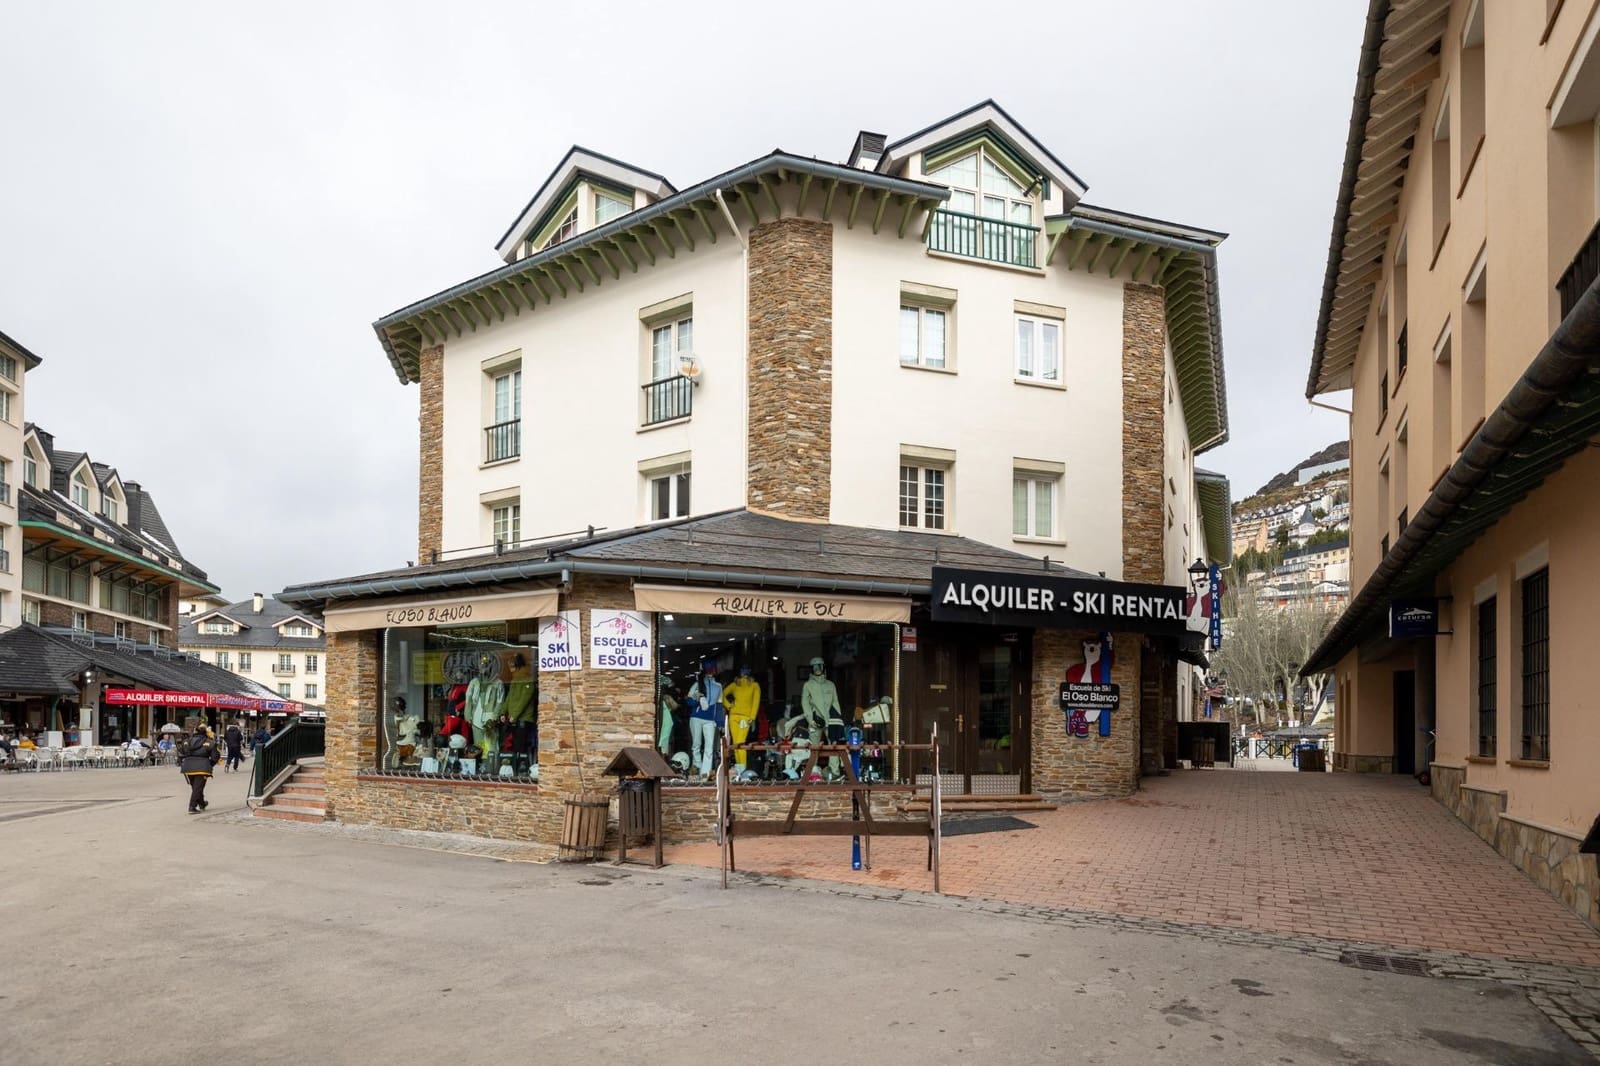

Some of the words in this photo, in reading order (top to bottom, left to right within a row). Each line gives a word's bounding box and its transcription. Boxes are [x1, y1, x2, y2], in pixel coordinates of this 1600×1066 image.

[712, 597, 787, 615] ALQUILER
[793, 601, 808, 614] DE
[814, 601, 846, 617] SKI
[942, 582, 1054, 612] ALQUILER
[1073, 591, 1105, 614] SKI
[1112, 594, 1187, 620] RENTAL
[428, 604, 472, 622] BLANCO
[547, 642, 570, 654] SKI
[593, 636, 648, 648] ESCUELA
[615, 647, 627, 655] DE
[541, 655, 580, 669] SCHOOL
[598, 653, 643, 667] ESQUÍ
[126, 692, 164, 703] ALQUILER
[165, 694, 178, 703] SKI
[178, 695, 206, 704] RENTAL
[1062, 691, 1070, 701] El
[1071, 691, 1089, 702] Oso
[1090, 692, 1118, 703] Blanco
